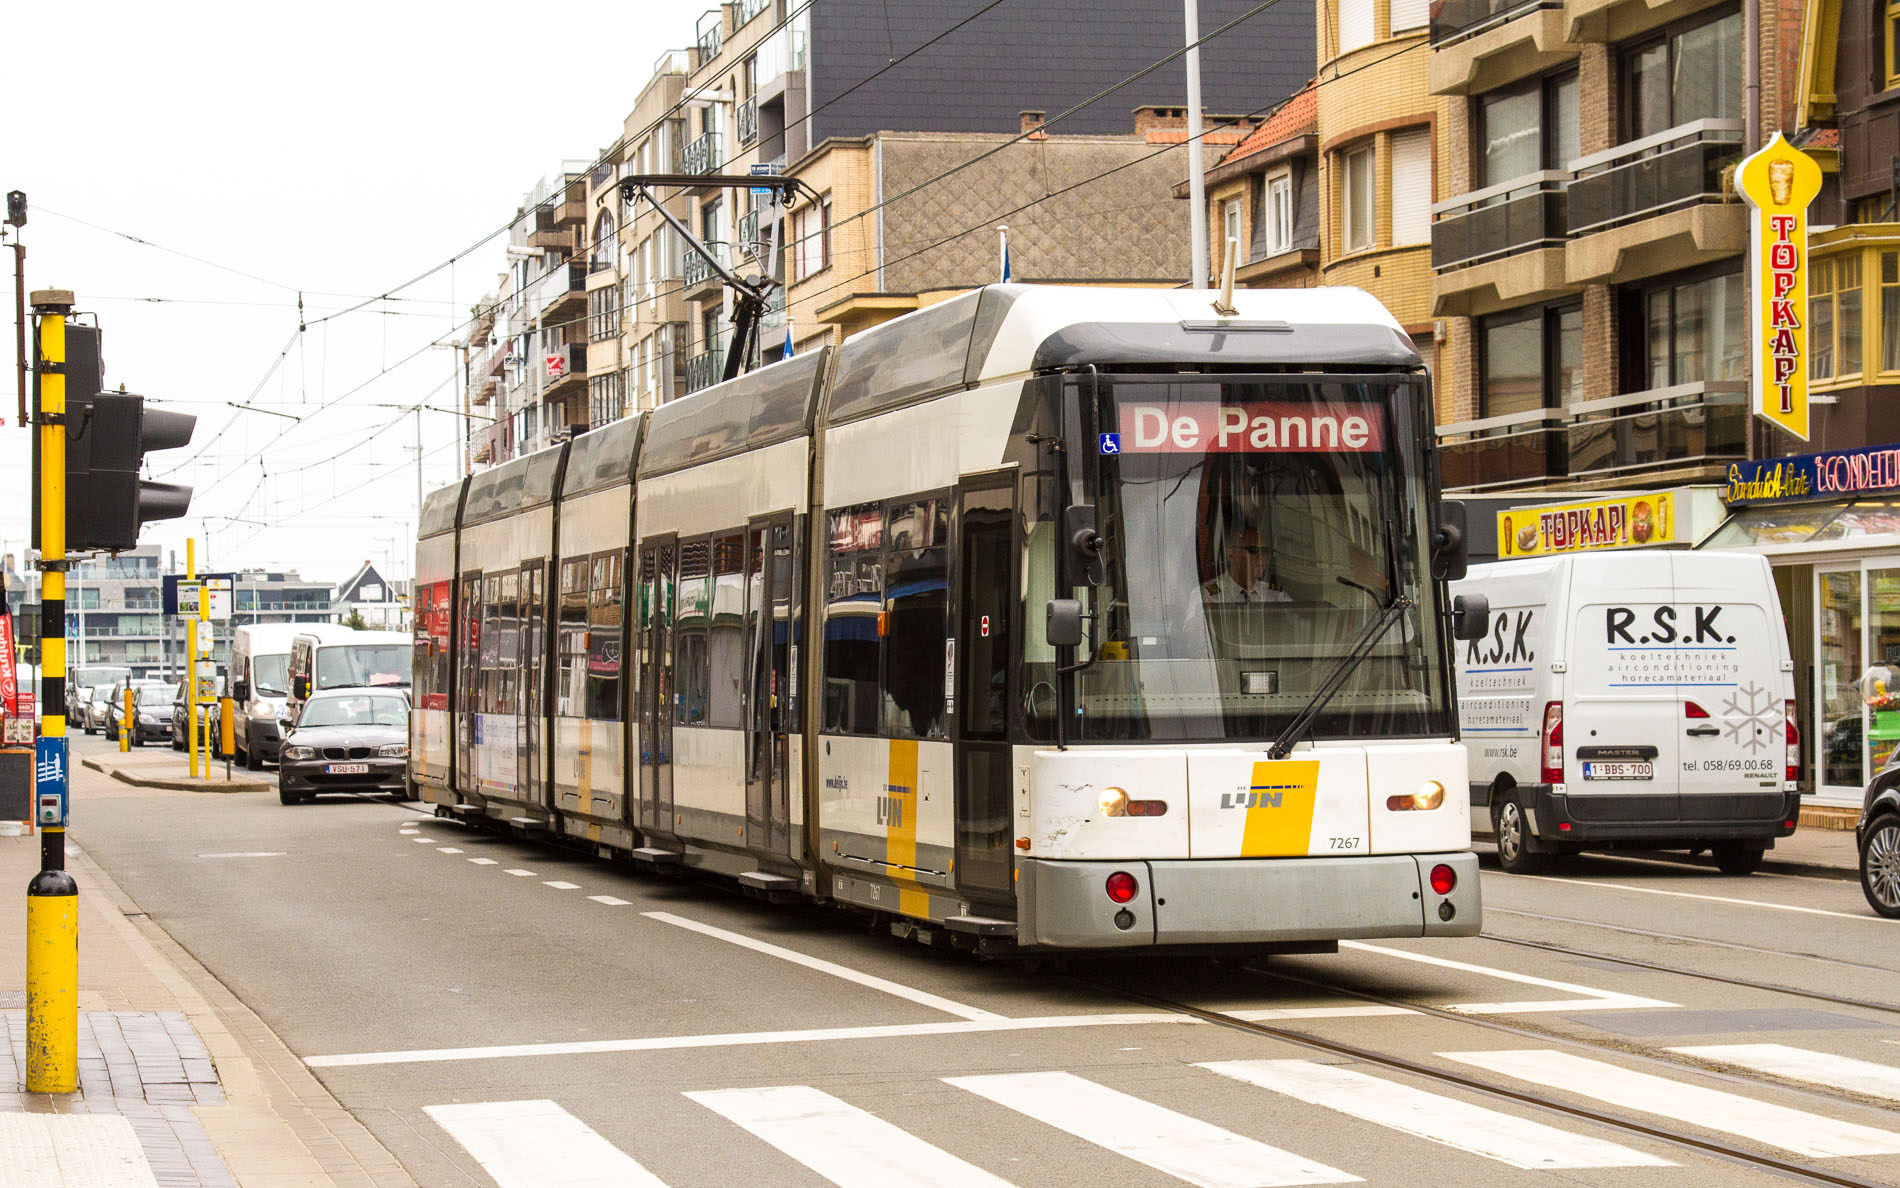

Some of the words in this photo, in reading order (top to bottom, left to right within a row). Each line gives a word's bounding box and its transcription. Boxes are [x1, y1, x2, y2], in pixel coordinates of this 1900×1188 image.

[1769, 215, 1801, 414] TOPKAPI
[1134, 407, 1200, 449] De
[1218, 407, 1369, 449] Panne
[1825, 449, 1900, 492] GONDELTJ
[1540, 503, 1628, 551] TOPKAPI
[1606, 605, 1736, 644] R.S.K.
[1620, 652, 1727, 661] koeltechniek
[1608, 663, 1739, 672] airconditioning
[1469, 674, 1526, 688] koeltechniek
[1622, 674, 1726, 682] horecamateriaal
[1461, 700, 1530, 711] airconditioning
[1484, 745, 1518, 759] www.rsk.be
[1592, 764, 1651, 775] 1-BBS-700
[1683, 761, 1700, 771] tel.
[1703, 760, 1773, 772] 058/69.00.68
[1220, 792, 1283, 809] LIJN
[877, 796, 902, 828] LIJN
[1329, 837, 1360, 849] 7267
